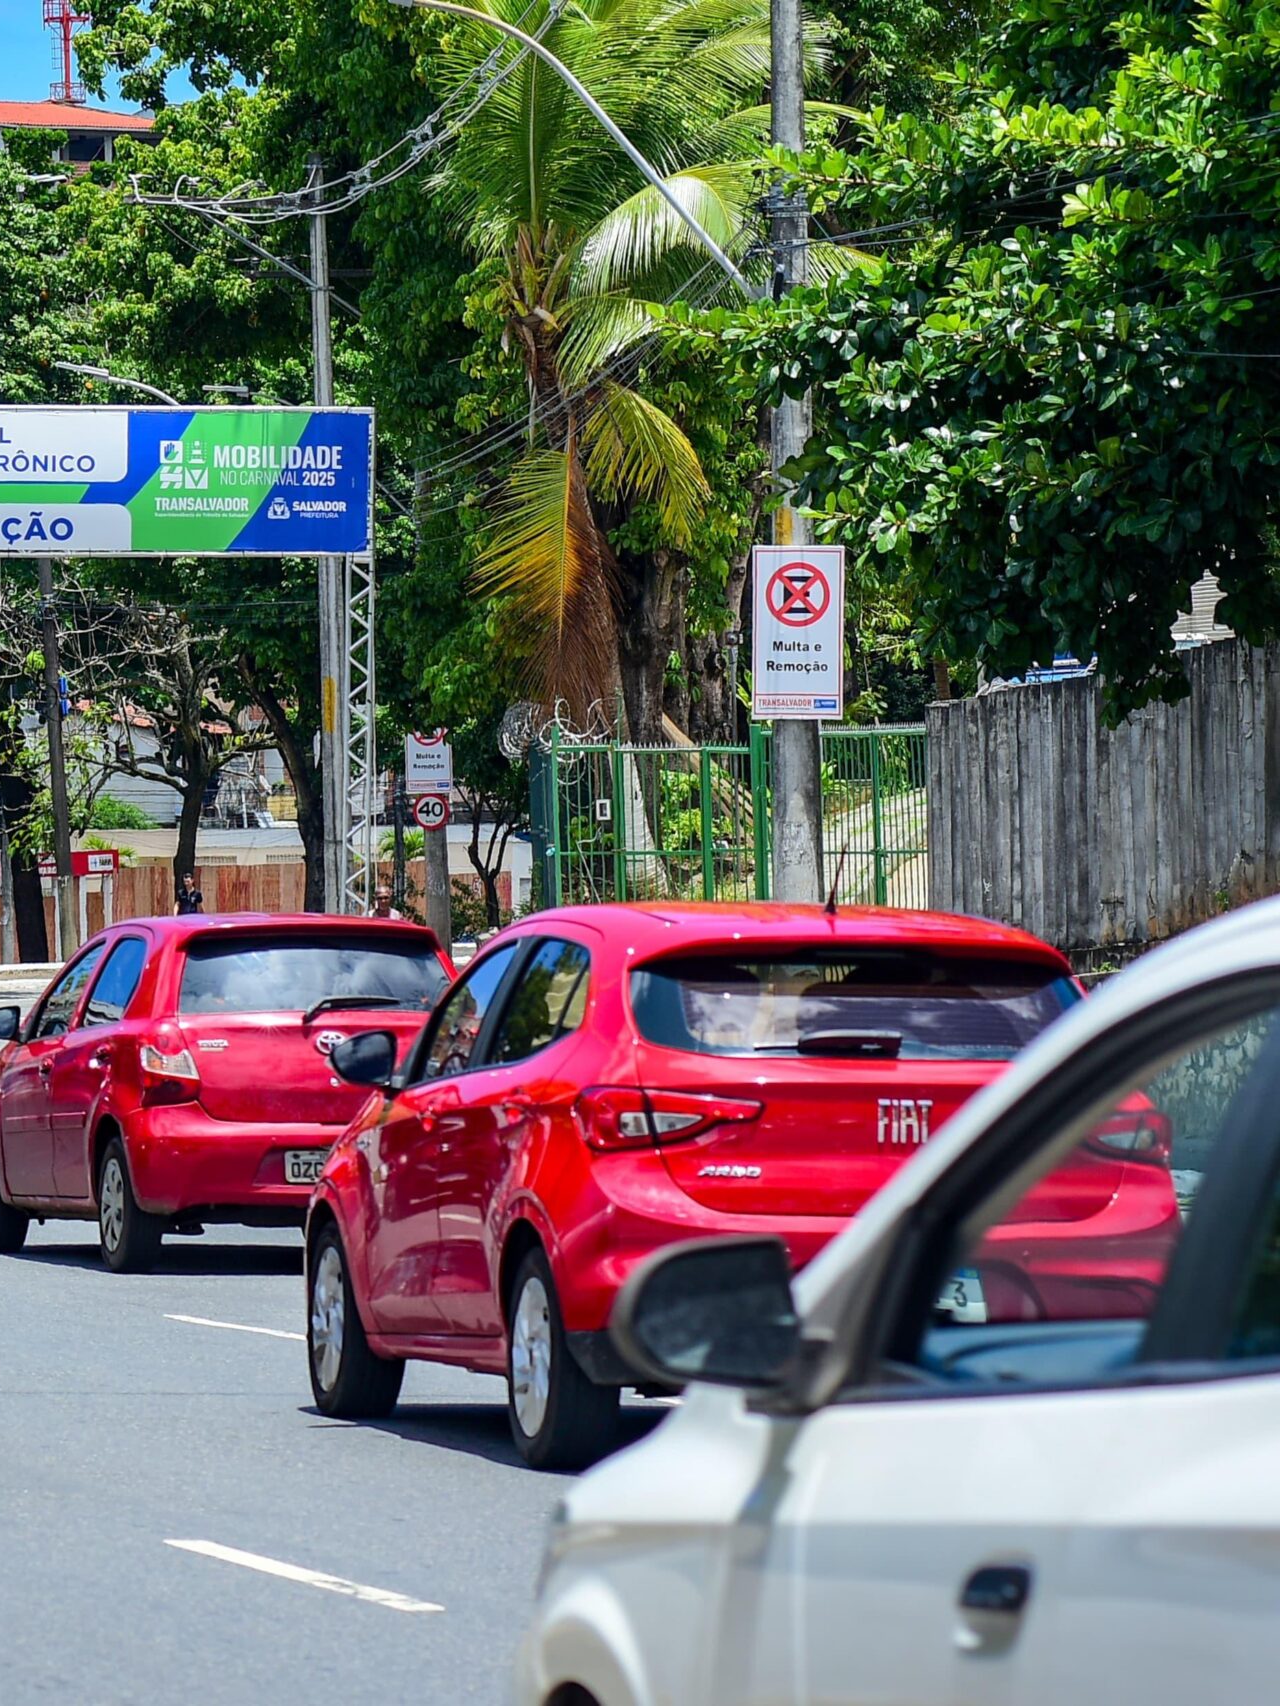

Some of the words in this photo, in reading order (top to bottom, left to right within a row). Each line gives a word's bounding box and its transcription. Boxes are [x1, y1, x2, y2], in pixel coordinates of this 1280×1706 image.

[213, 445, 342, 469] MOBILIDADE
[220, 471, 236, 486] NO
[240, 471, 300, 486] CARNAVAL
[302, 471, 335, 487] 2025
[154, 497, 249, 511] TRANSALVADOR
[292, 501, 347, 512] SALVADOR
[773, 641, 810, 652] Multa
[814, 643, 822, 652] e
[766, 660, 829, 674] Remoção
[758, 698, 812, 708] TRANSALVADOR
[418, 801, 443, 817] 40
[877, 1098, 933, 1144] FIAT
